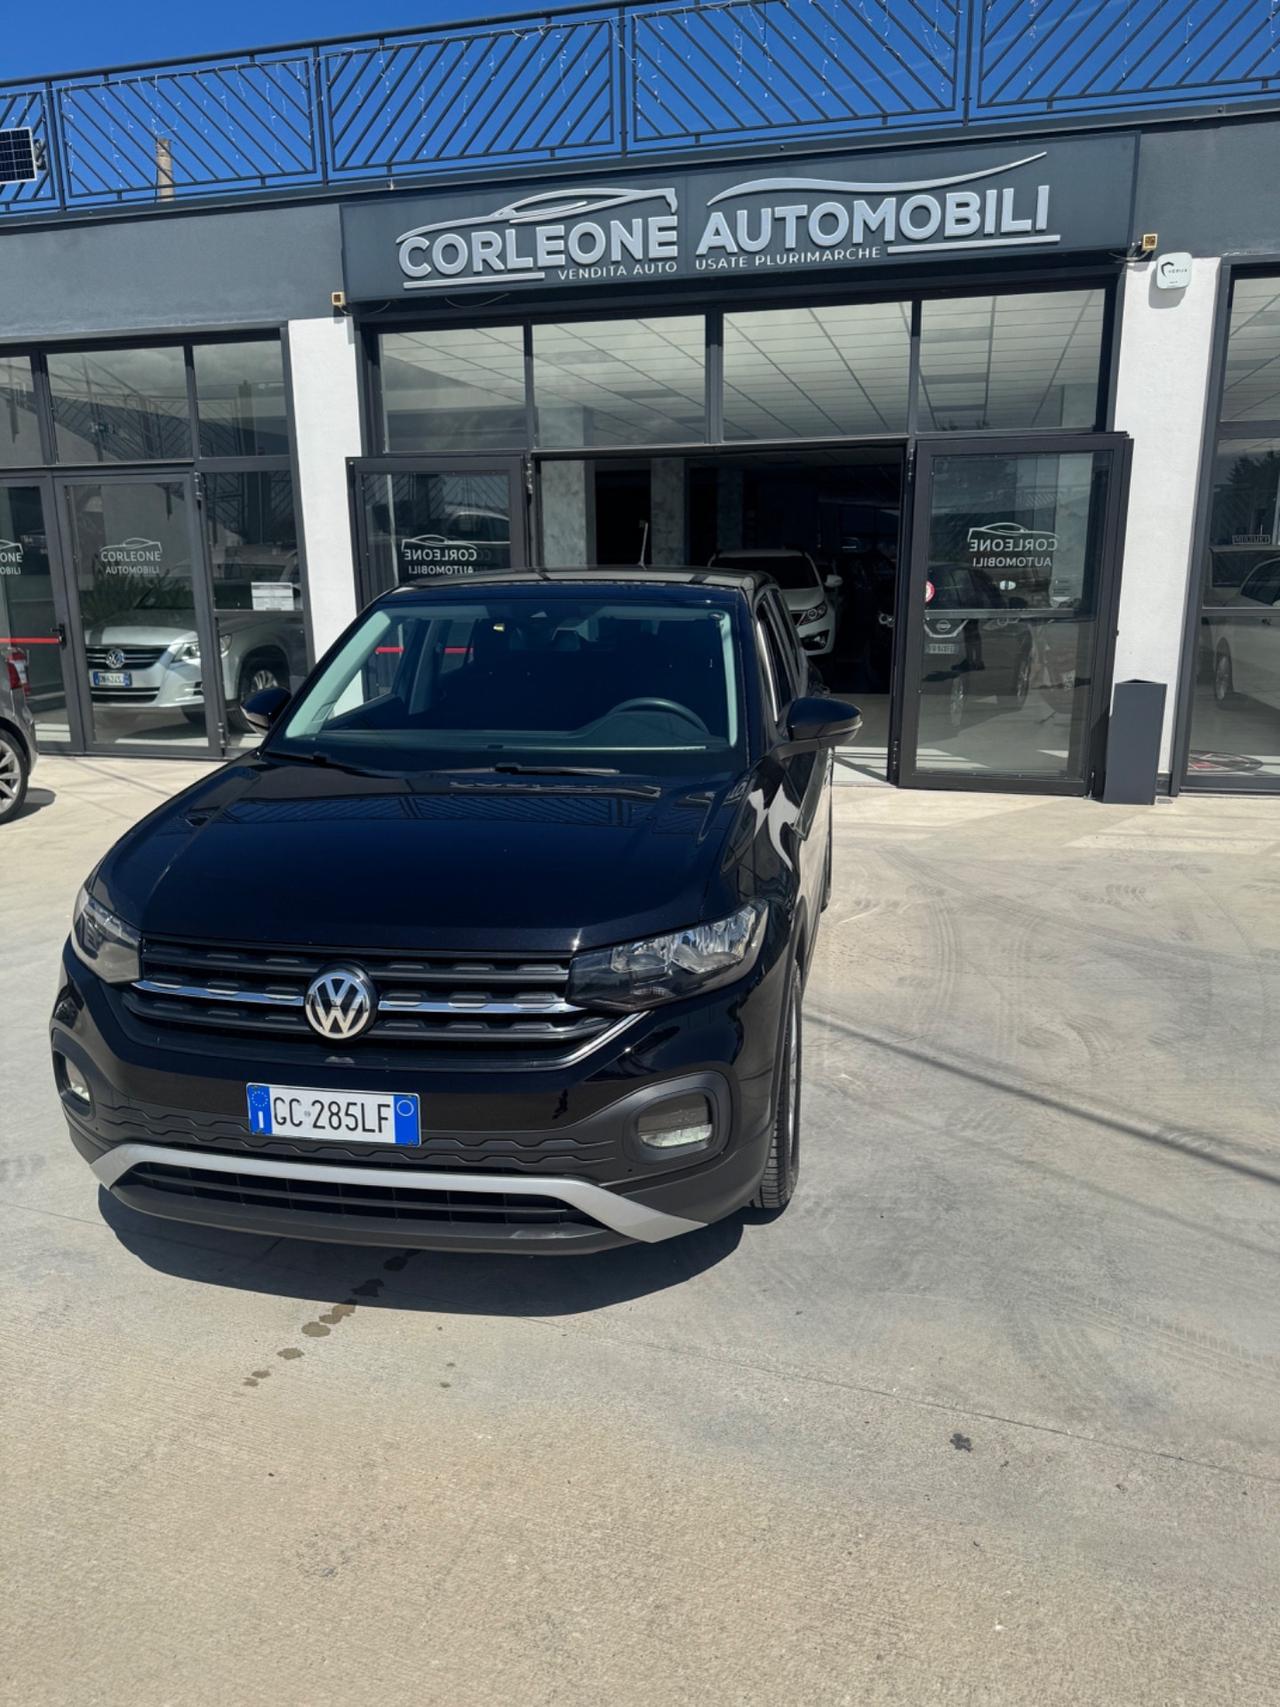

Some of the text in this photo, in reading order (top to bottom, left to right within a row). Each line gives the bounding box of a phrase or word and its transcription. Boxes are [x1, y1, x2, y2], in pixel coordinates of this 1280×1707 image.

[399, 184, 1050, 279] CORLEONE AUTOMOBILI
[558, 246, 881, 281] VENDITA AUTO USATE PLURIMARCHE
[100, 551, 161, 562] CORLEONE
[105, 566, 160, 576] AUTOMOBILI
[307, 973, 369, 1038] VW
